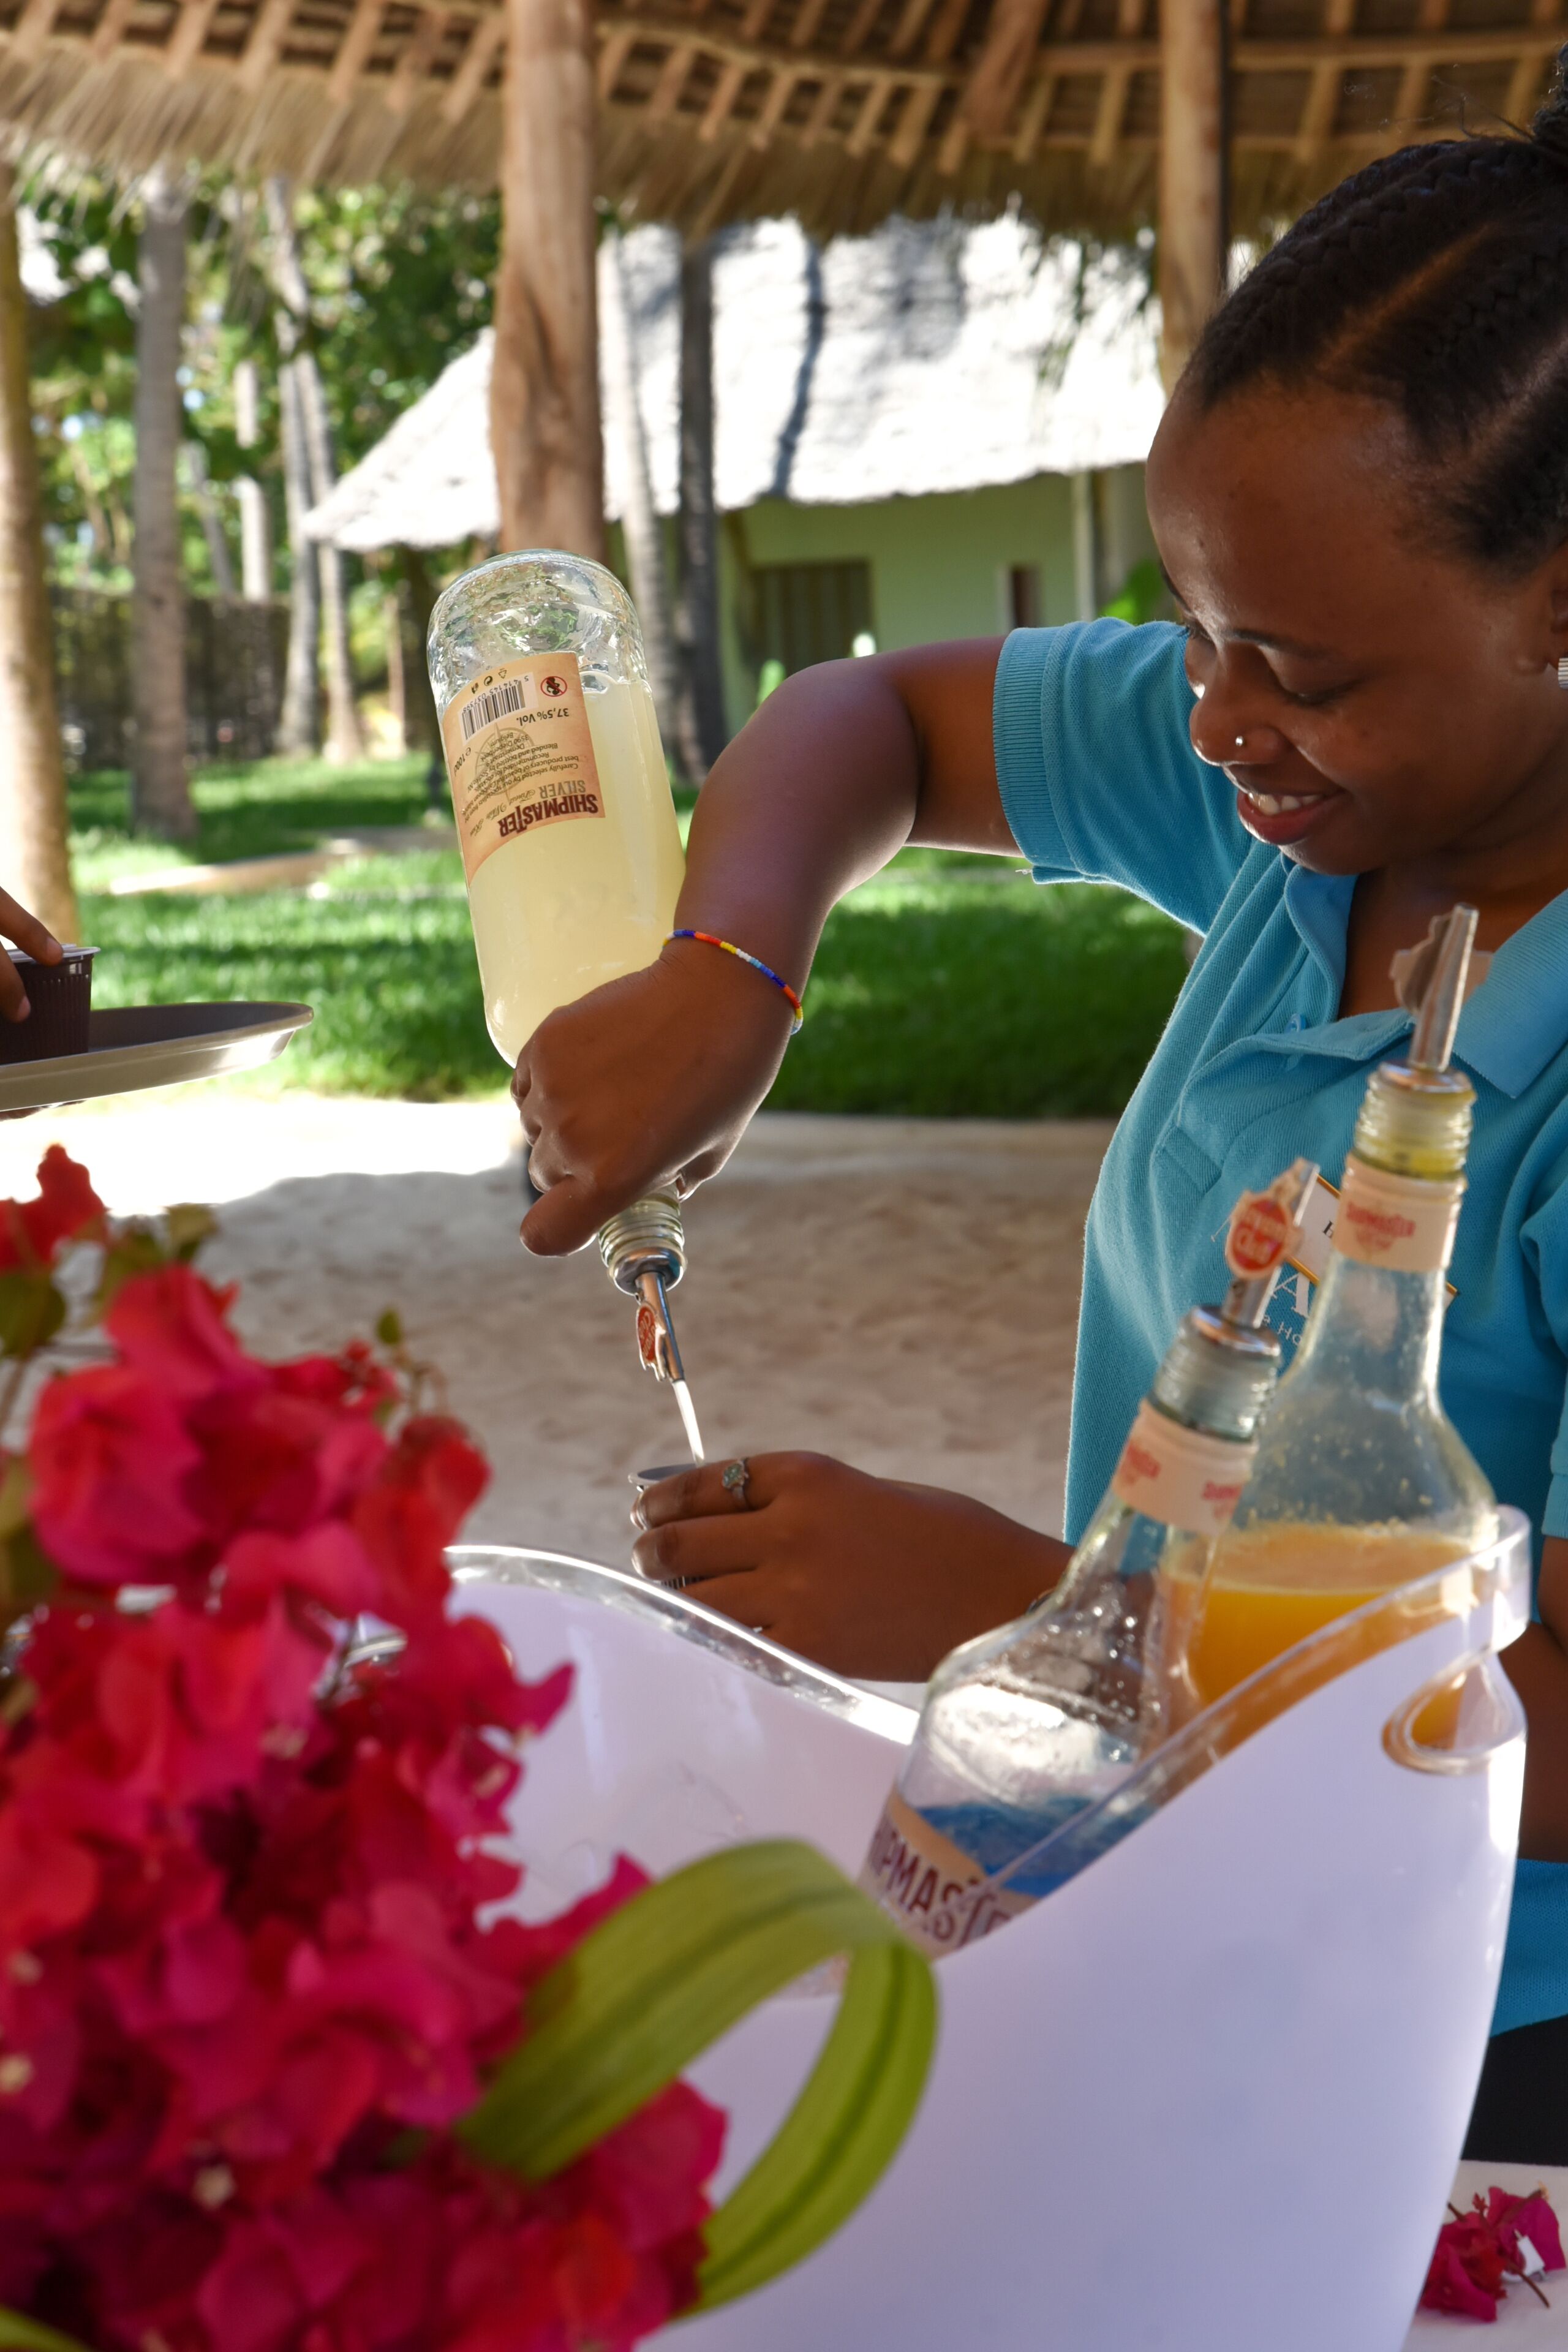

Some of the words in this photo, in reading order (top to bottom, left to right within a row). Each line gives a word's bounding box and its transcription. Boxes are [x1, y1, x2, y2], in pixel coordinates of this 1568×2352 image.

[489, 680, 518, 695] 414145
[516, 714, 535, 726] Vol.
[537, 708, 569, 720] 37,5%
[490, 733, 513, 747] Belgium
[518, 750, 529, 758] and
[531, 743, 557, 754] Blended
[496, 755, 517, 769] bottled
[503, 752, 549, 773] Recommended
[530, 756, 563, 768] producers
[549, 763, 578, 772] Carefully
[522, 768, 548, 780] selected
[538, 780, 586, 799] SILVER
[509, 790, 535, 806] Finest
[497, 794, 598, 837] SHIPMASTER
